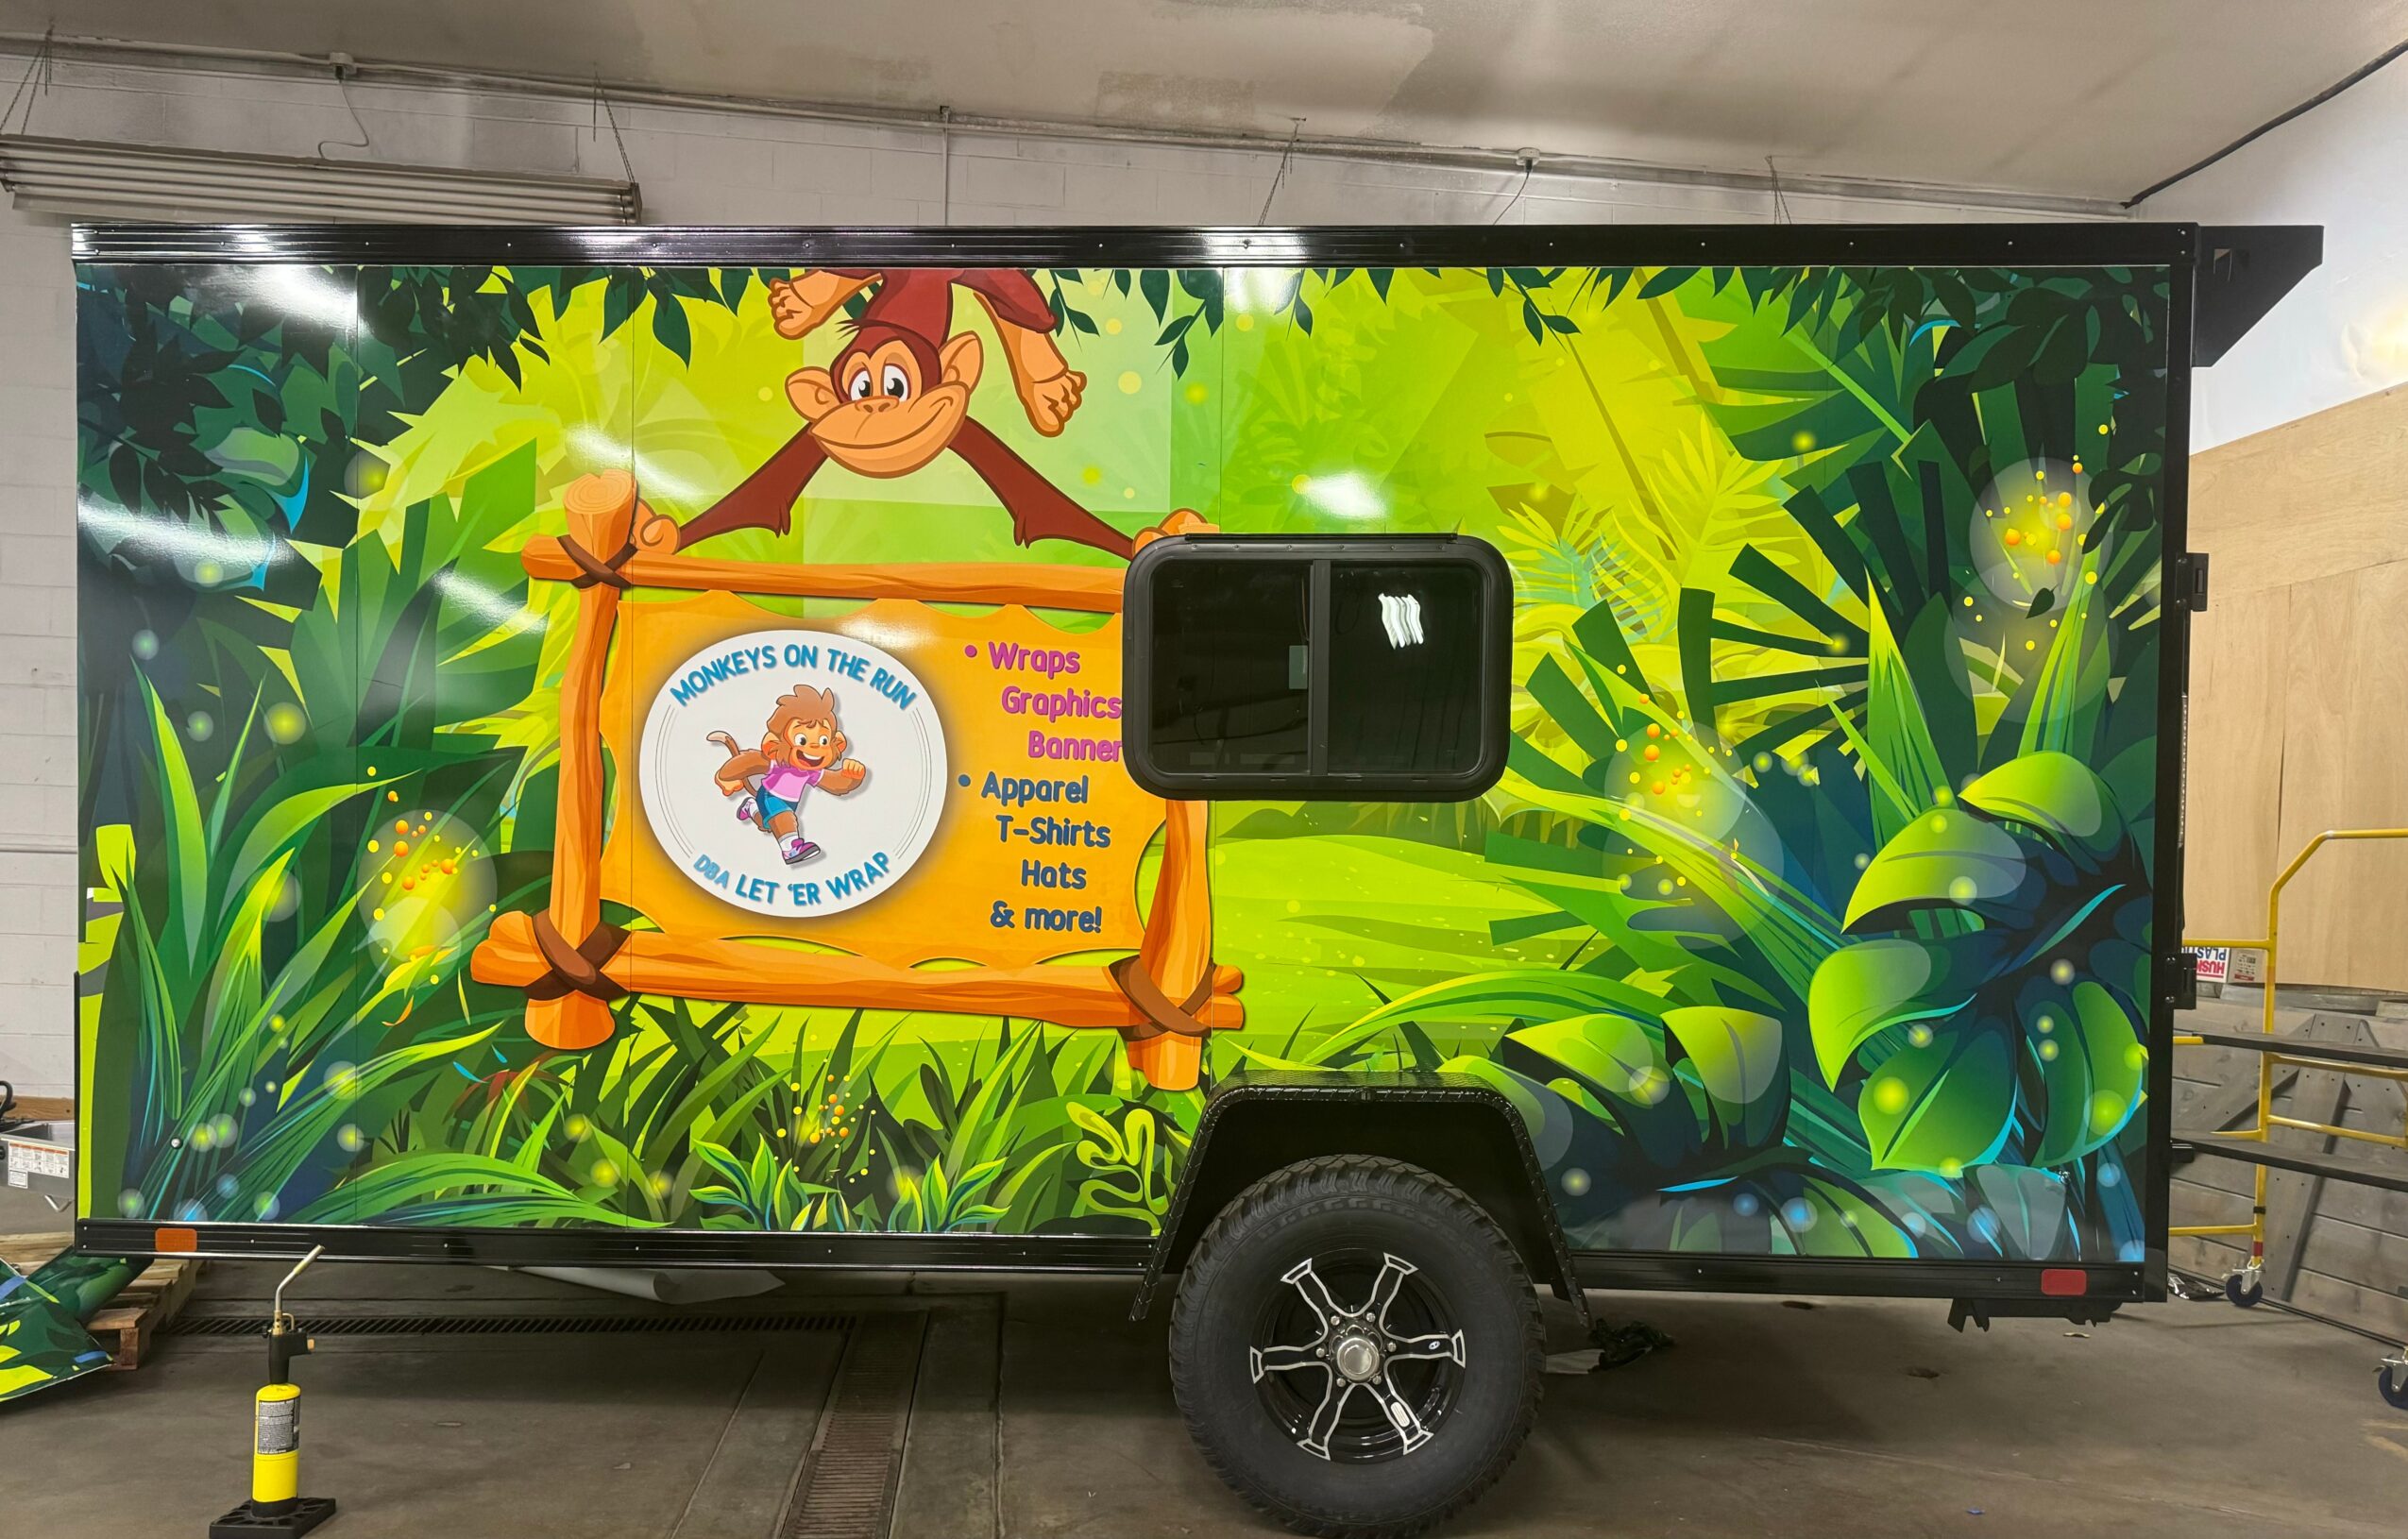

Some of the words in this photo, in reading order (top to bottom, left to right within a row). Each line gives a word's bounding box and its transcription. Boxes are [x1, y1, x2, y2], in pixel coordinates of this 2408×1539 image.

[670, 644, 777, 707] MONKEYS
[783, 643, 818, 668] ON
[827, 648, 871, 683] THE
[869, 668, 917, 710] RUN
[988, 641, 1080, 679] Wraps
[1001, 685, 1122, 723] Graphics
[981, 770, 1089, 807] Apparel
[995, 814, 1111, 848] T-Shirts
[693, 854, 730, 888] DBA
[735, 873, 780, 904] LET
[825, 851, 890, 900] WRAP
[1020, 859, 1087, 889] Hats
[990, 900, 1015, 928] &
[1026, 906, 1103, 933] more!
